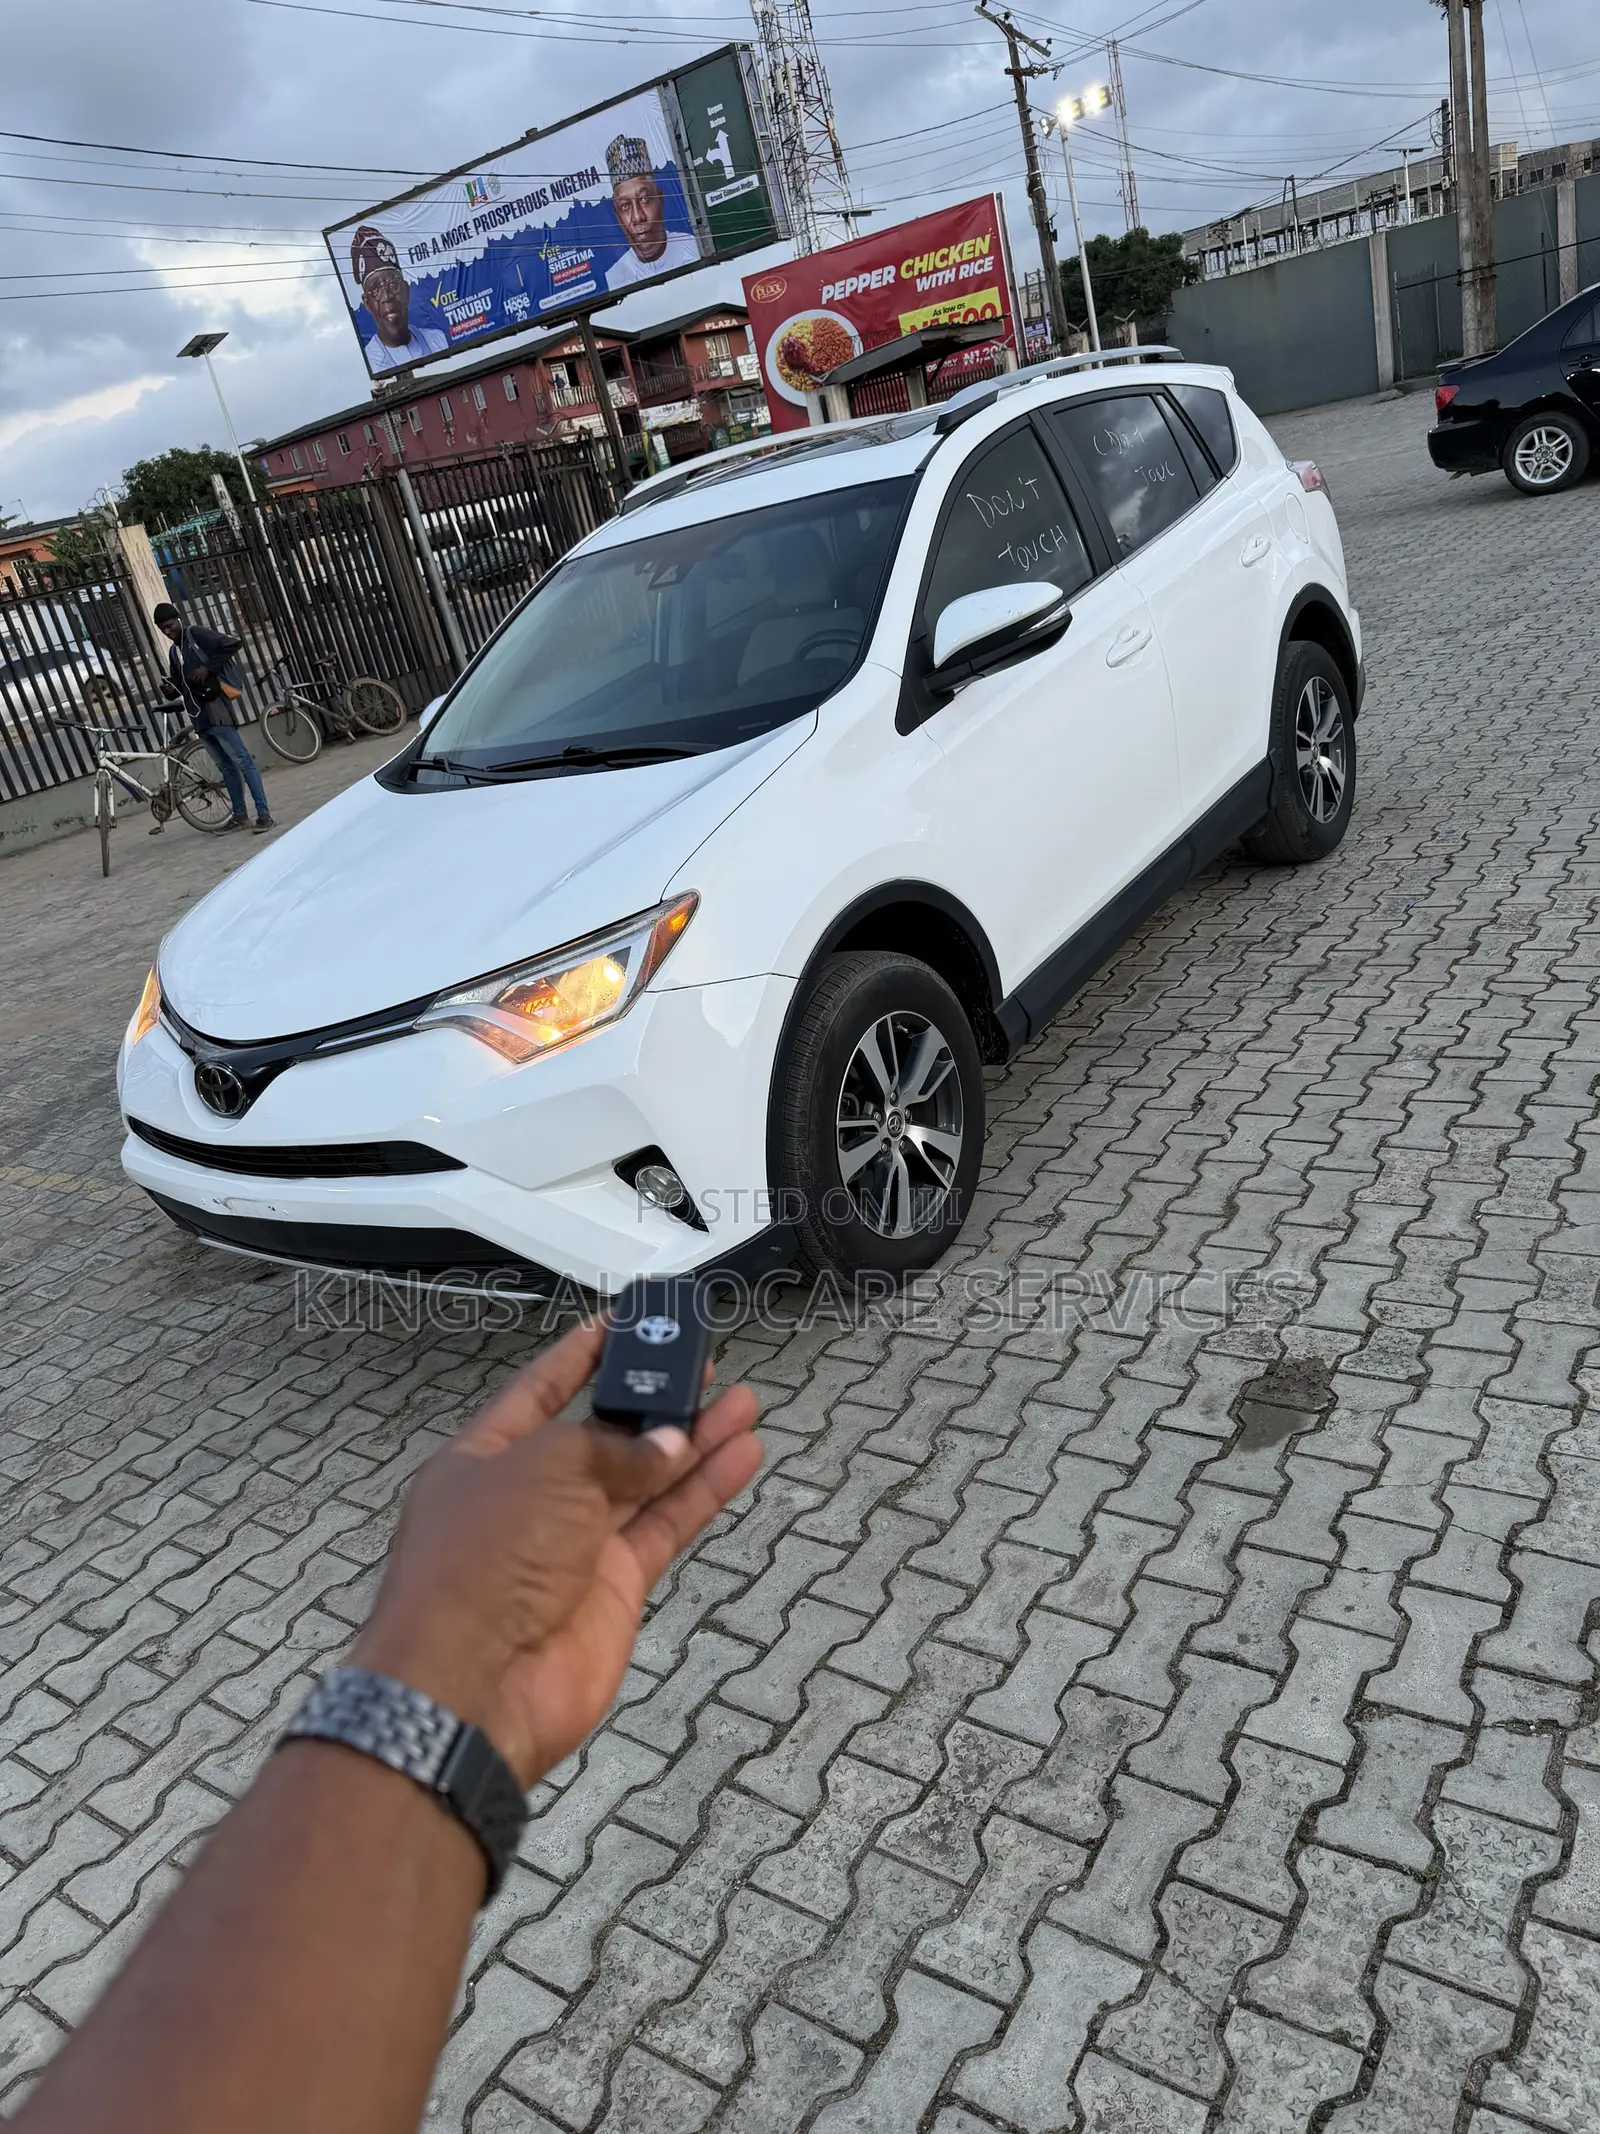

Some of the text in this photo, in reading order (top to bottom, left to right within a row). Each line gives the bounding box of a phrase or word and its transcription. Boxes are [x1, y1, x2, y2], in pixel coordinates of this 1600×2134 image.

[408, 241, 430, 264] FOR
[431, 237, 441, 256] A
[440, 221, 473, 251] MORE
[472, 187, 550, 236] PROSPEROUS
[549, 166, 601, 201] NIGERIA
[549, 248, 595, 273] SHETTIMA
[821, 234, 991, 305] PEPPER CHICKEN
[915, 255, 994, 293] WITH RICE
[445, 295, 492, 325] TINUBU
[503, 296, 530, 316] Hope
[932, 302, 966, 317] As low as
[705, 318, 738, 331] PLAZA
[998, 525, 1069, 571] TOUCH
